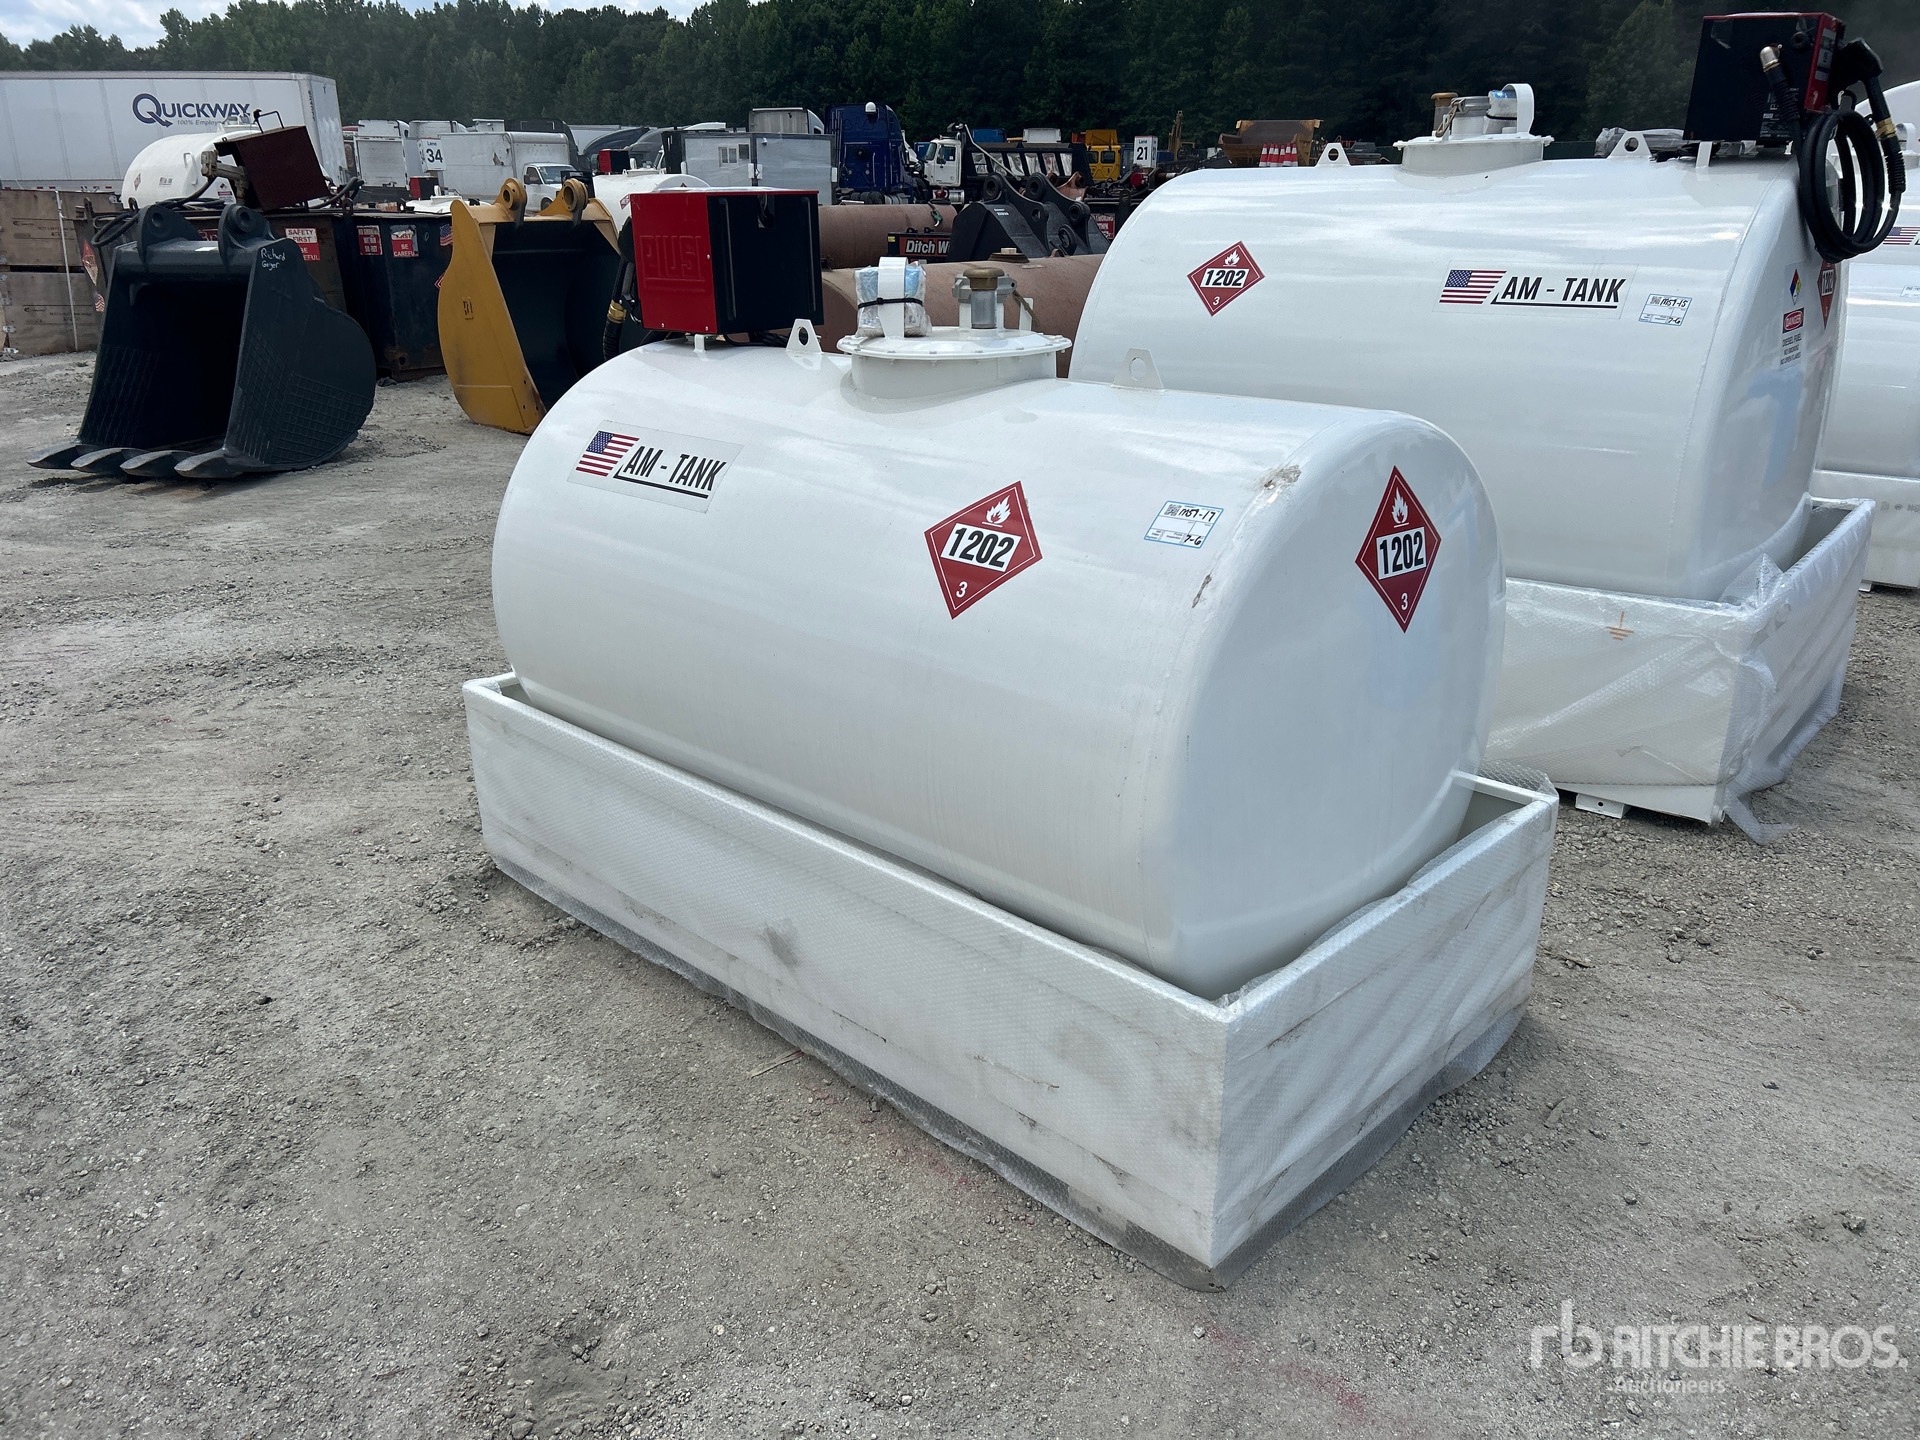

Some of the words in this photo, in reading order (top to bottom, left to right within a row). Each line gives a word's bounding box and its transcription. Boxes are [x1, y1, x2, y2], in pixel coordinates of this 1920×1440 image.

[132, 93, 251, 127] QUICKWAY
[195, 119, 220, 127] Employ
[426, 148, 443, 163] 34
[1136, 146, 1148, 160] 21
[905, 240, 935, 254] Ditch
[1205, 269, 1246, 287] 1202
[1501, 276, 1543, 300] AM
[1561, 277, 1627, 303] TANK
[1212, 296, 1220, 306] 3
[622, 445, 664, 477] AM
[668, 453, 727, 491] TANK
[948, 527, 1015, 568] 1202
[1184, 534, 1202, 546] 7-6
[1379, 531, 1424, 575] 1202
[956, 581, 968, 598] 3
[1401, 592, 1408, 610] 3
